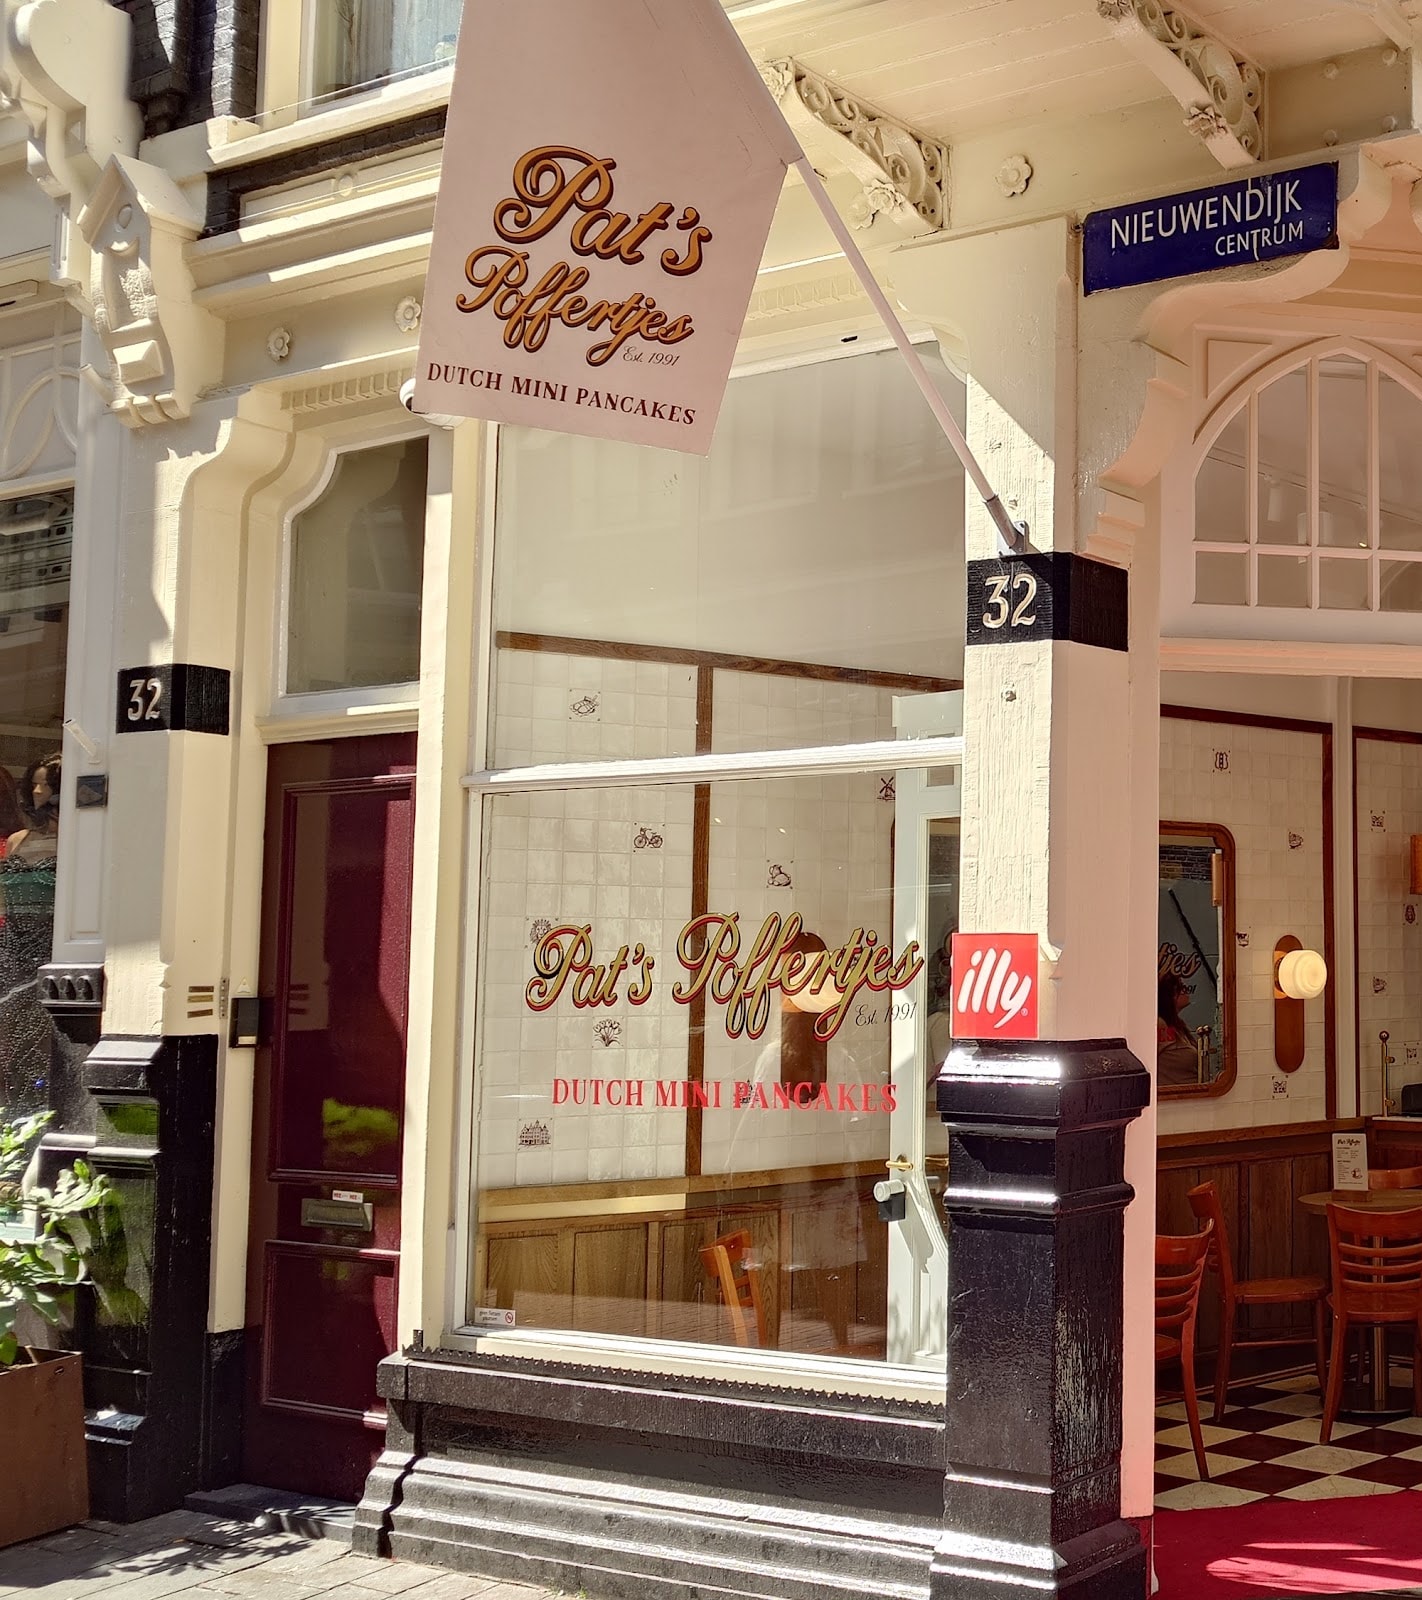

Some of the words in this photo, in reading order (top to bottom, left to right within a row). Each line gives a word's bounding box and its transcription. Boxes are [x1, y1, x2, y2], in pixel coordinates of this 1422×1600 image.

[493, 145, 712, 276] Pat's
[1111, 179, 1302, 249] NIEUWENDIJK
[1215, 220, 1303, 256] CENTRUM
[455, 245, 695, 367] Poffertjes
[622, 345, 644, 363] Est.
[647, 352, 681, 367] 1991
[427, 362, 503, 391] DUTCH
[511, 375, 568, 403] MINI
[575, 387, 697, 426] PANCAKES
[982, 573, 1037, 629] 32
[127, 677, 162, 721] 32
[525, 923, 656, 1012] Pat's
[672, 911, 925, 1042] Poffertjes
[957, 947, 1032, 1029] illy
[855, 1003, 878, 1027] Est.
[884, 1001, 918, 1023] 1991
[551, 1078, 644, 1107] DUTCH
[654, 1079, 722, 1109] MINI
[732, 1081, 899, 1114] PANCAKES
